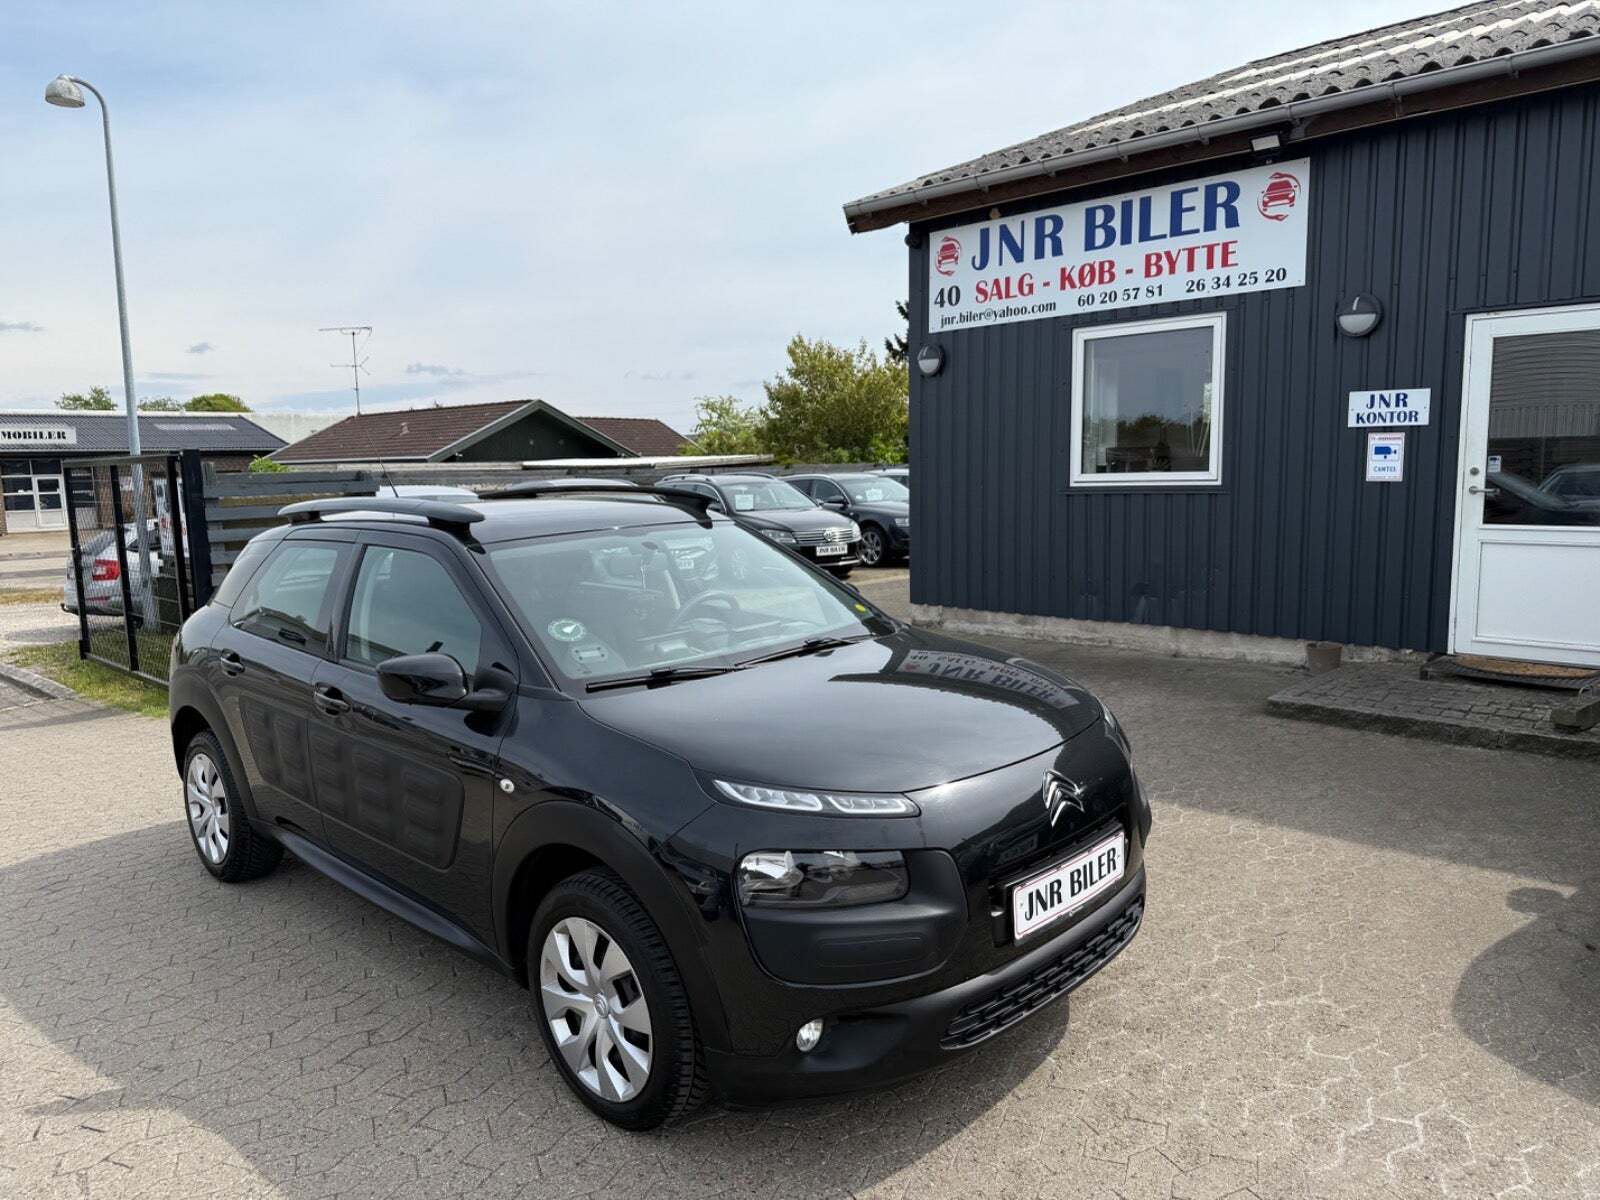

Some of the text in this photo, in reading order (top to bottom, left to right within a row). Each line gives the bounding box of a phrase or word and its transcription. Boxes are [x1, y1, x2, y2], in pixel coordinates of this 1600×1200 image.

[971, 180, 1241, 271] JNR BILER
[975, 272, 1034, 304] SALG
[1059, 259, 1116, 291] KØB
[1144, 240, 1239, 278] BYTTE
[1186, 267, 1287, 293] 26 34 25 20
[934, 285, 961, 308] 40
[1078, 284, 1163, 307] 60 20 57 81
[940, 301, 1057, 328] jnr.biler@yahoo.com
[1366, 392, 1409, 409] JNR
[1356, 410, 1419, 424] KONTOR
[1024, 847, 1117, 921] JNR BILER
